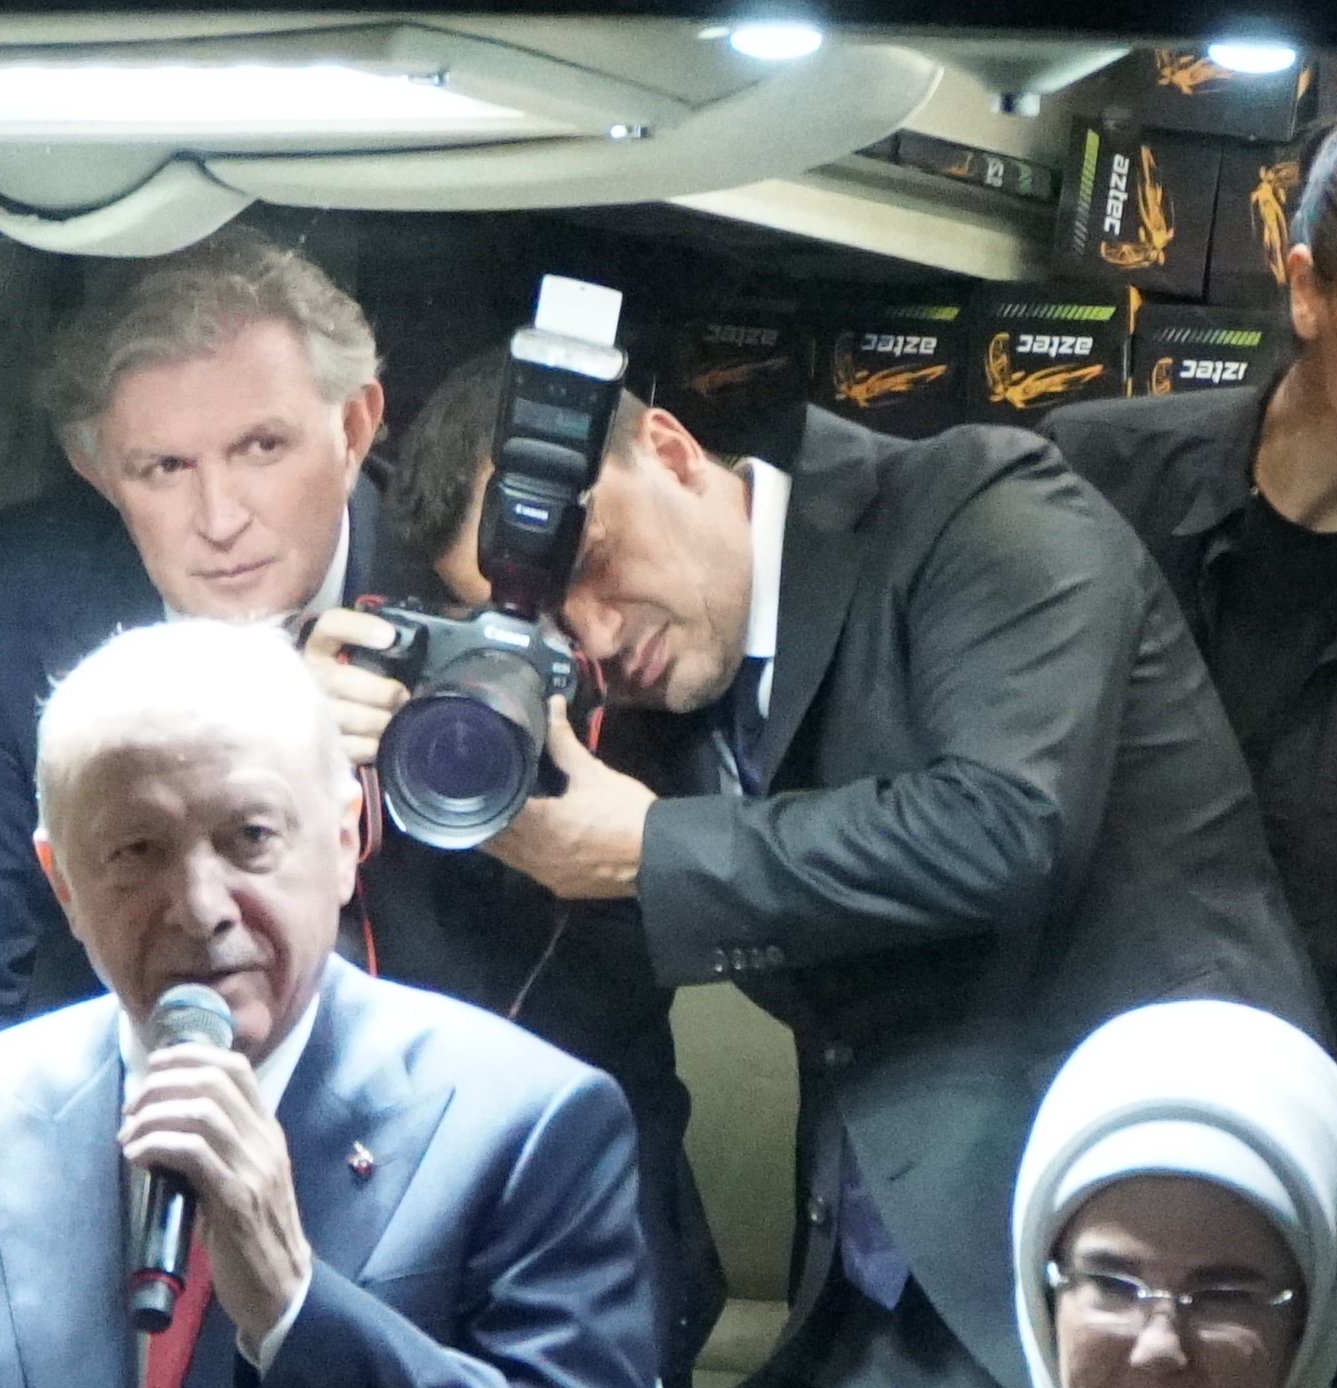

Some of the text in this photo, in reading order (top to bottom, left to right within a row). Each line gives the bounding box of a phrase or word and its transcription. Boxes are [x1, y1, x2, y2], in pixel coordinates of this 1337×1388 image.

[1103, 153, 1130, 237] aztec
[861, 333, 938, 358] aztec
[1016, 334, 1094, 358] aztec
